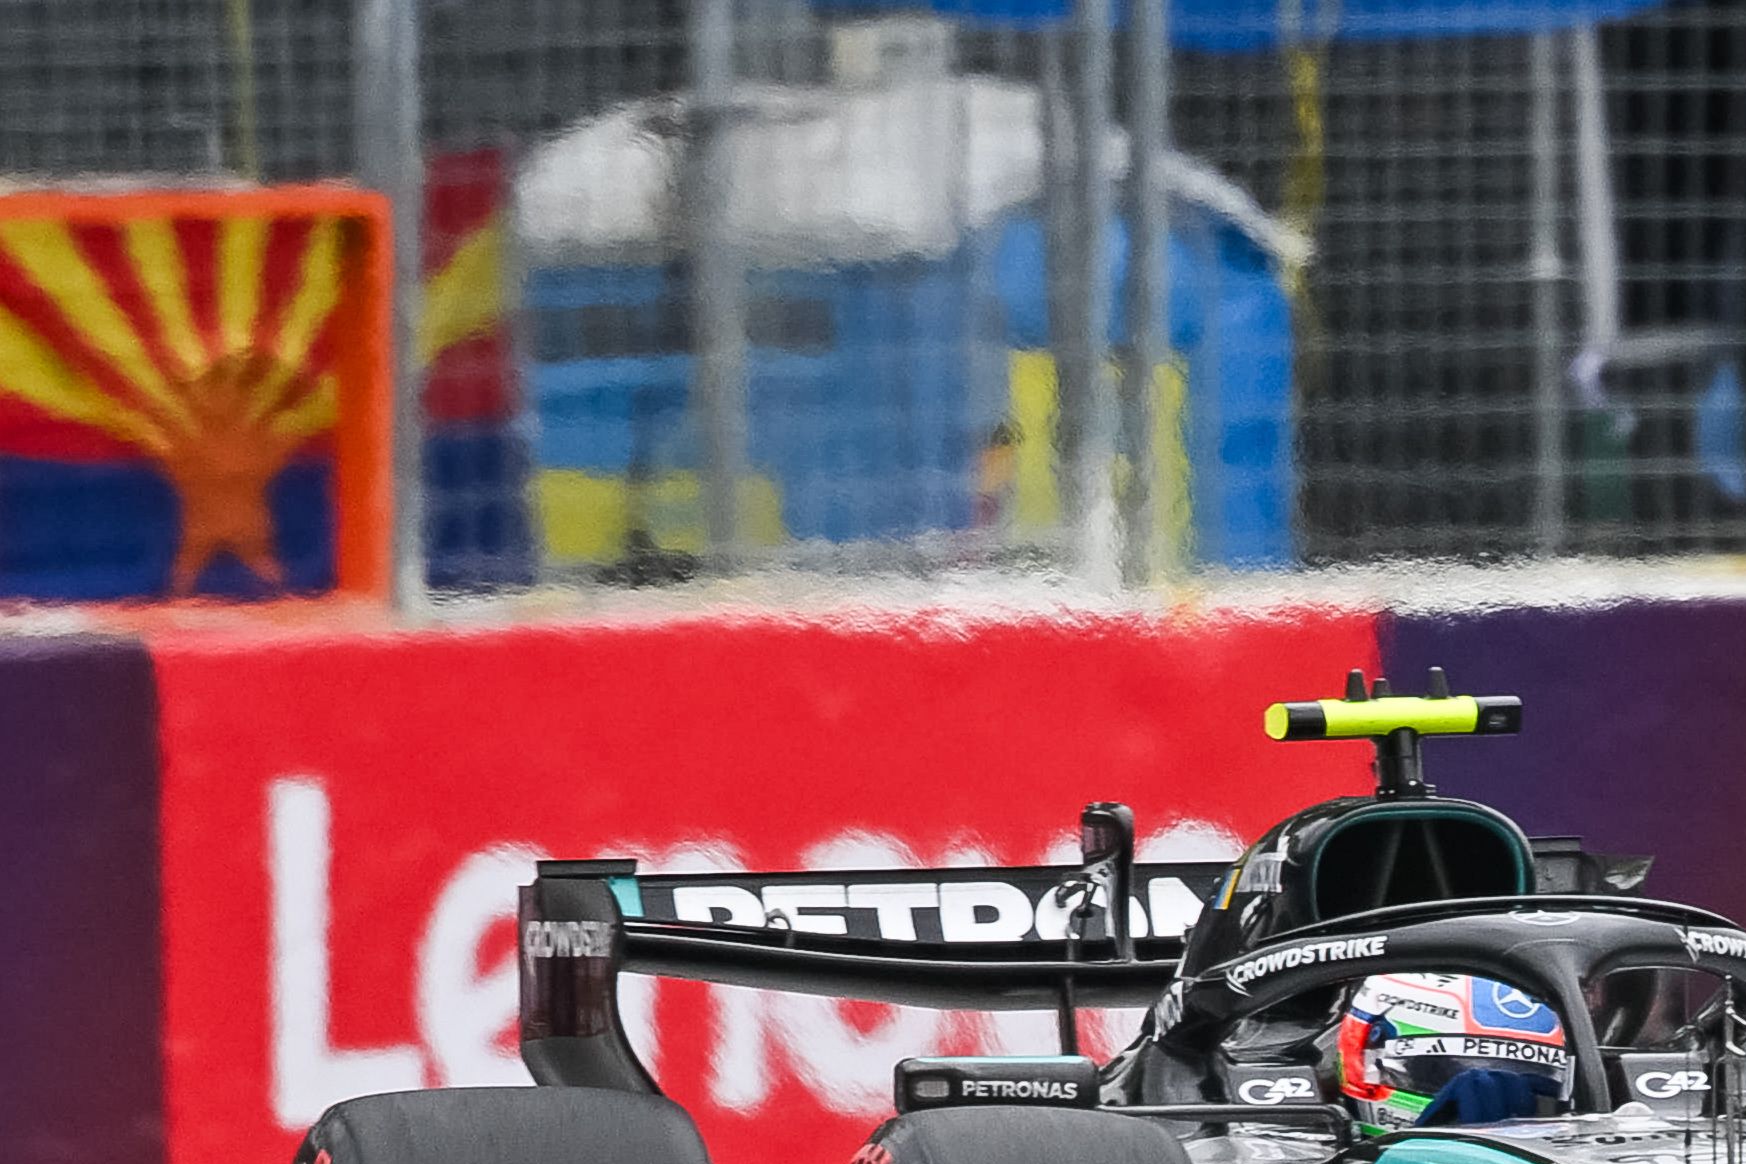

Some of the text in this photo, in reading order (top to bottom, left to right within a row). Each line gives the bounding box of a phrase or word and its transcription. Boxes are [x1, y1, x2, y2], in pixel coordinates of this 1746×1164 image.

[1233, 935, 1389, 983] CROWDSTRIKE
[962, 1079, 1079, 1100] PETRONAS
[1238, 1078, 1315, 1105] G42
[1635, 1070, 1712, 1098] G42
